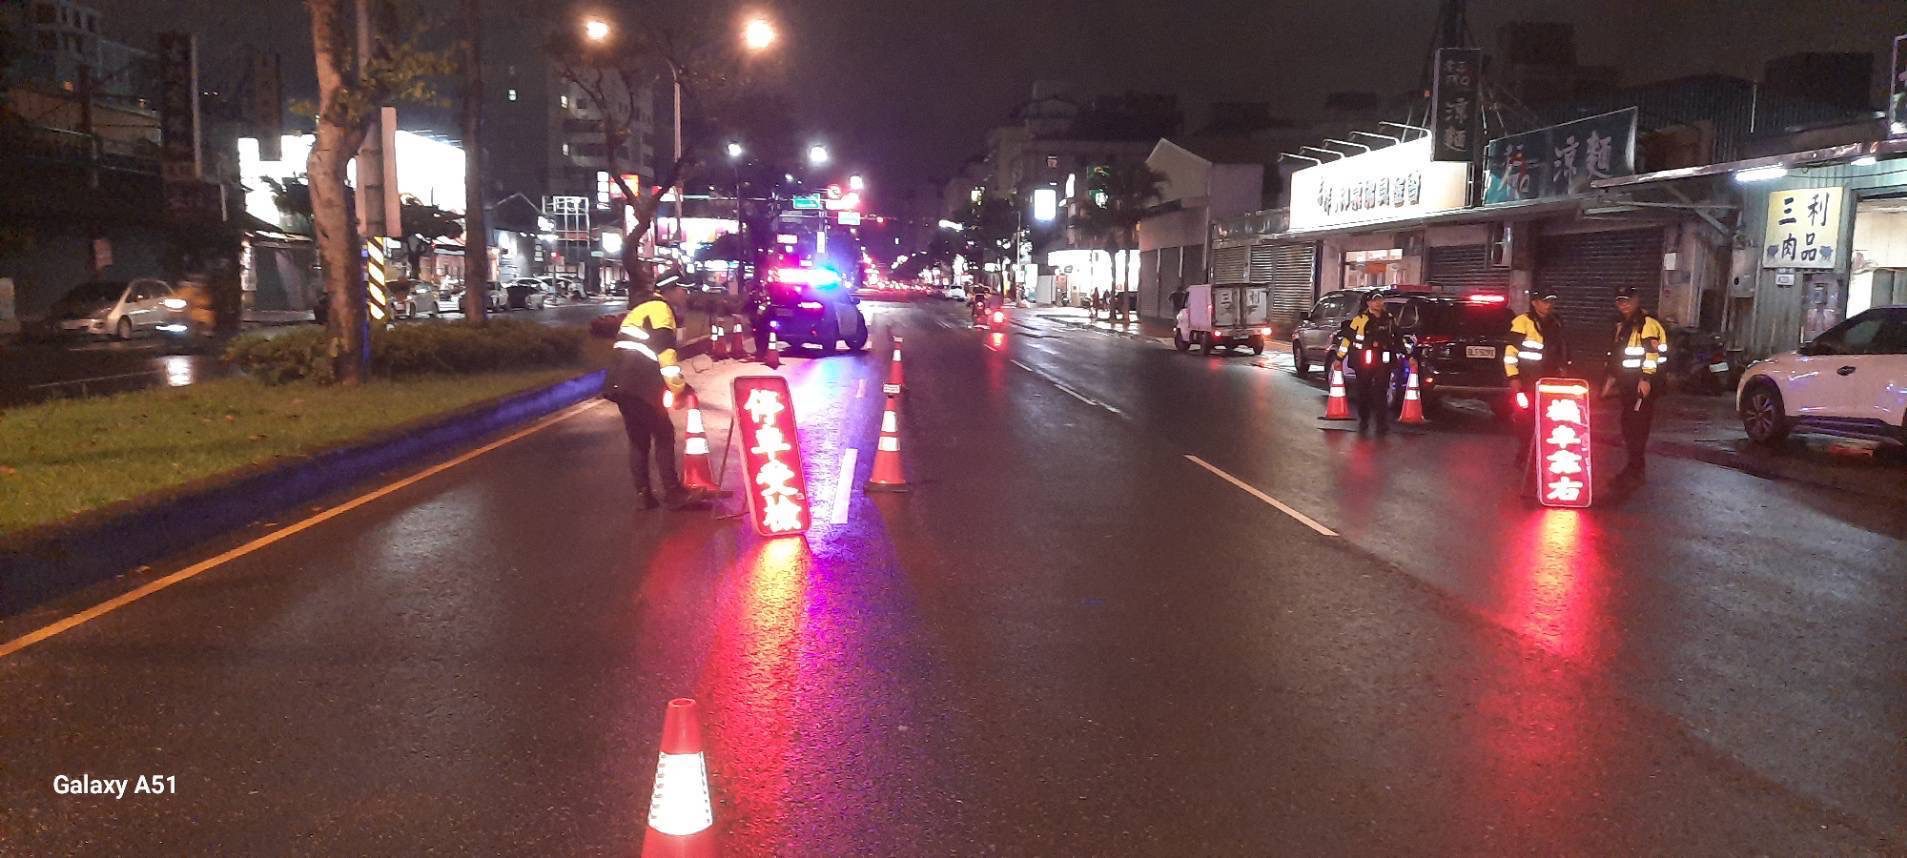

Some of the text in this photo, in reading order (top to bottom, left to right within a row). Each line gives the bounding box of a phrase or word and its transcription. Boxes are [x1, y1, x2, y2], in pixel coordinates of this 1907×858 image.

[1779, 192, 1830, 227] 三利
[1782, 232, 1818, 261] 肉品
[744, 388, 803, 533] 停車受檢
